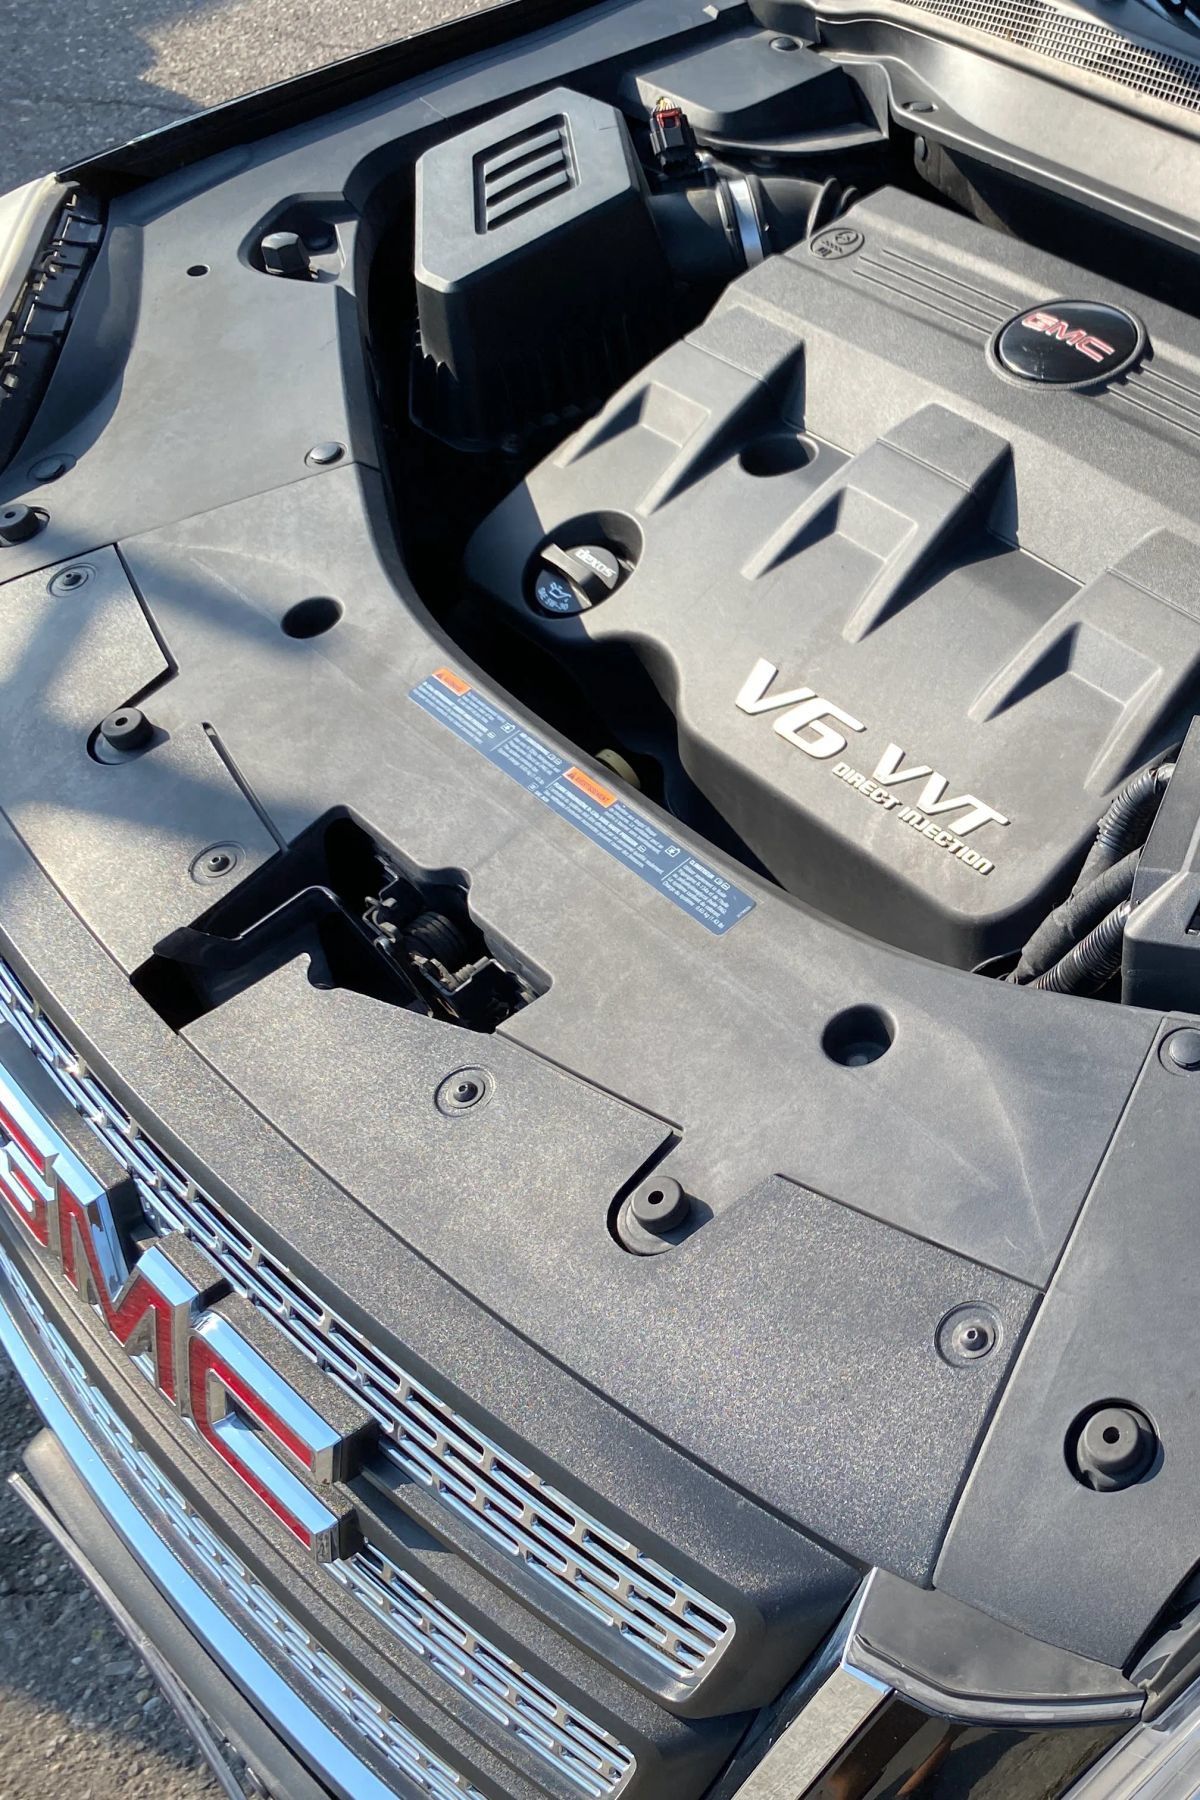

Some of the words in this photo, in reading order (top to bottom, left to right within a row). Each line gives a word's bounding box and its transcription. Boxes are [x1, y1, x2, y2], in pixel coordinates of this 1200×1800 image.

[1022, 312, 1116, 363] GMC
[574, 548, 617, 578] dexos
[735, 657, 866, 760] V6
[872, 742, 1010, 836] VVT
[831, 761, 902, 812] DIRECT
[897, 806, 996, 876] INJECTION
